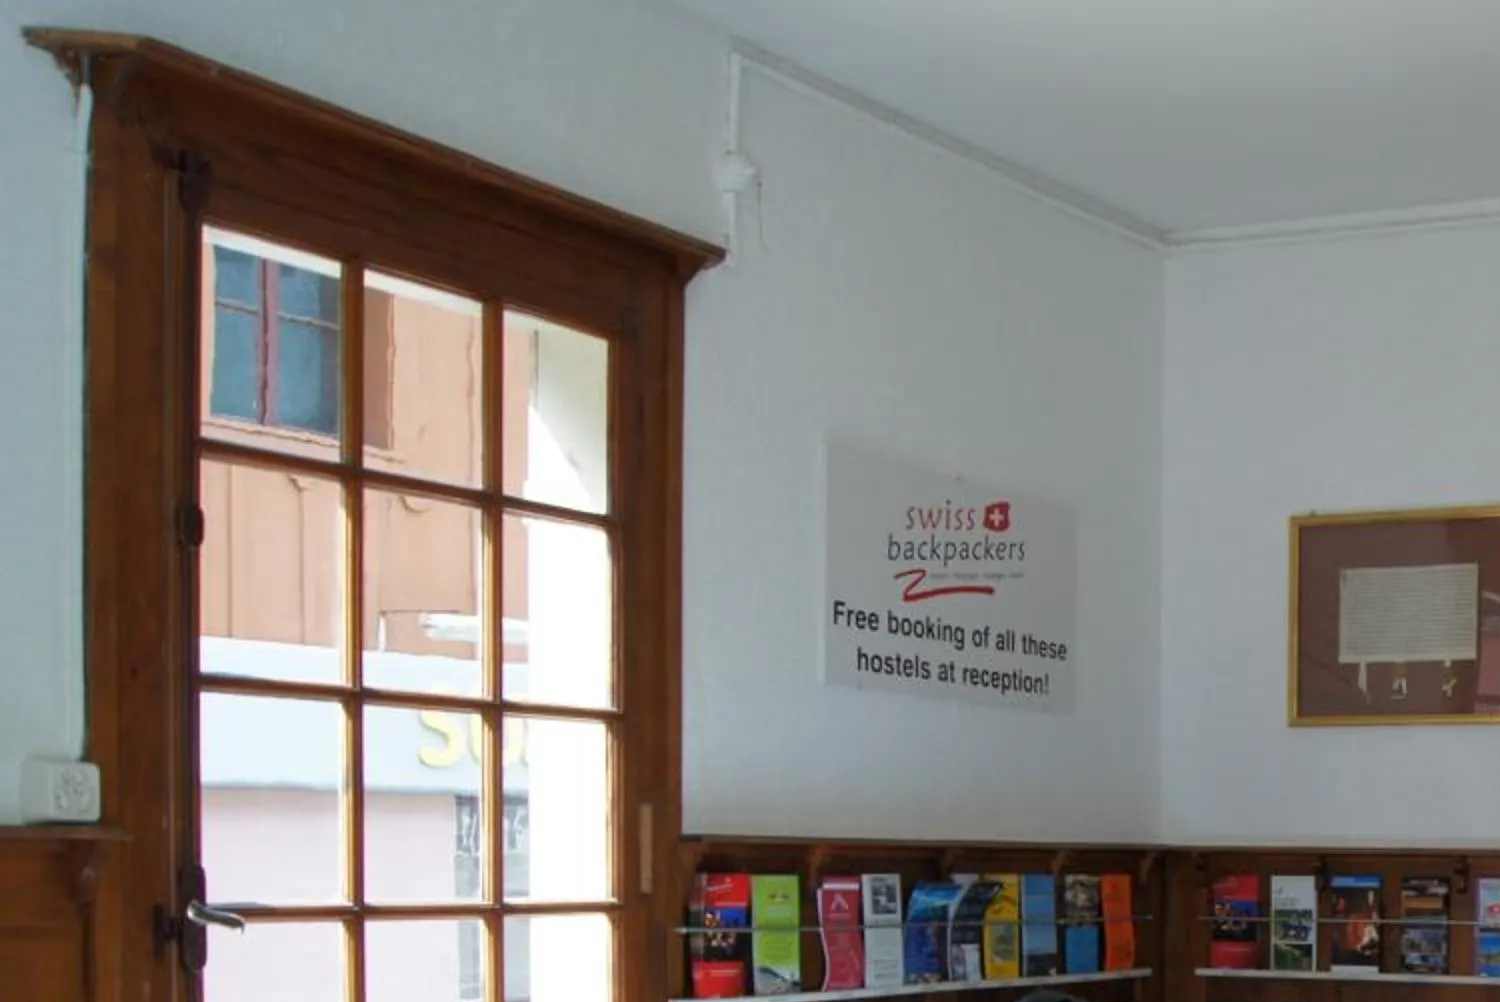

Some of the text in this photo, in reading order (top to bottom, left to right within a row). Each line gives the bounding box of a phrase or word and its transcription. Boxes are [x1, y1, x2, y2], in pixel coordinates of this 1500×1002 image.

[906, 500, 976, 532] swiss
[887, 534, 1025, 567] backpackers
[833, 600, 1067, 662] Free booking of all these
[857, 647, 1050, 696] hostels at reception!
